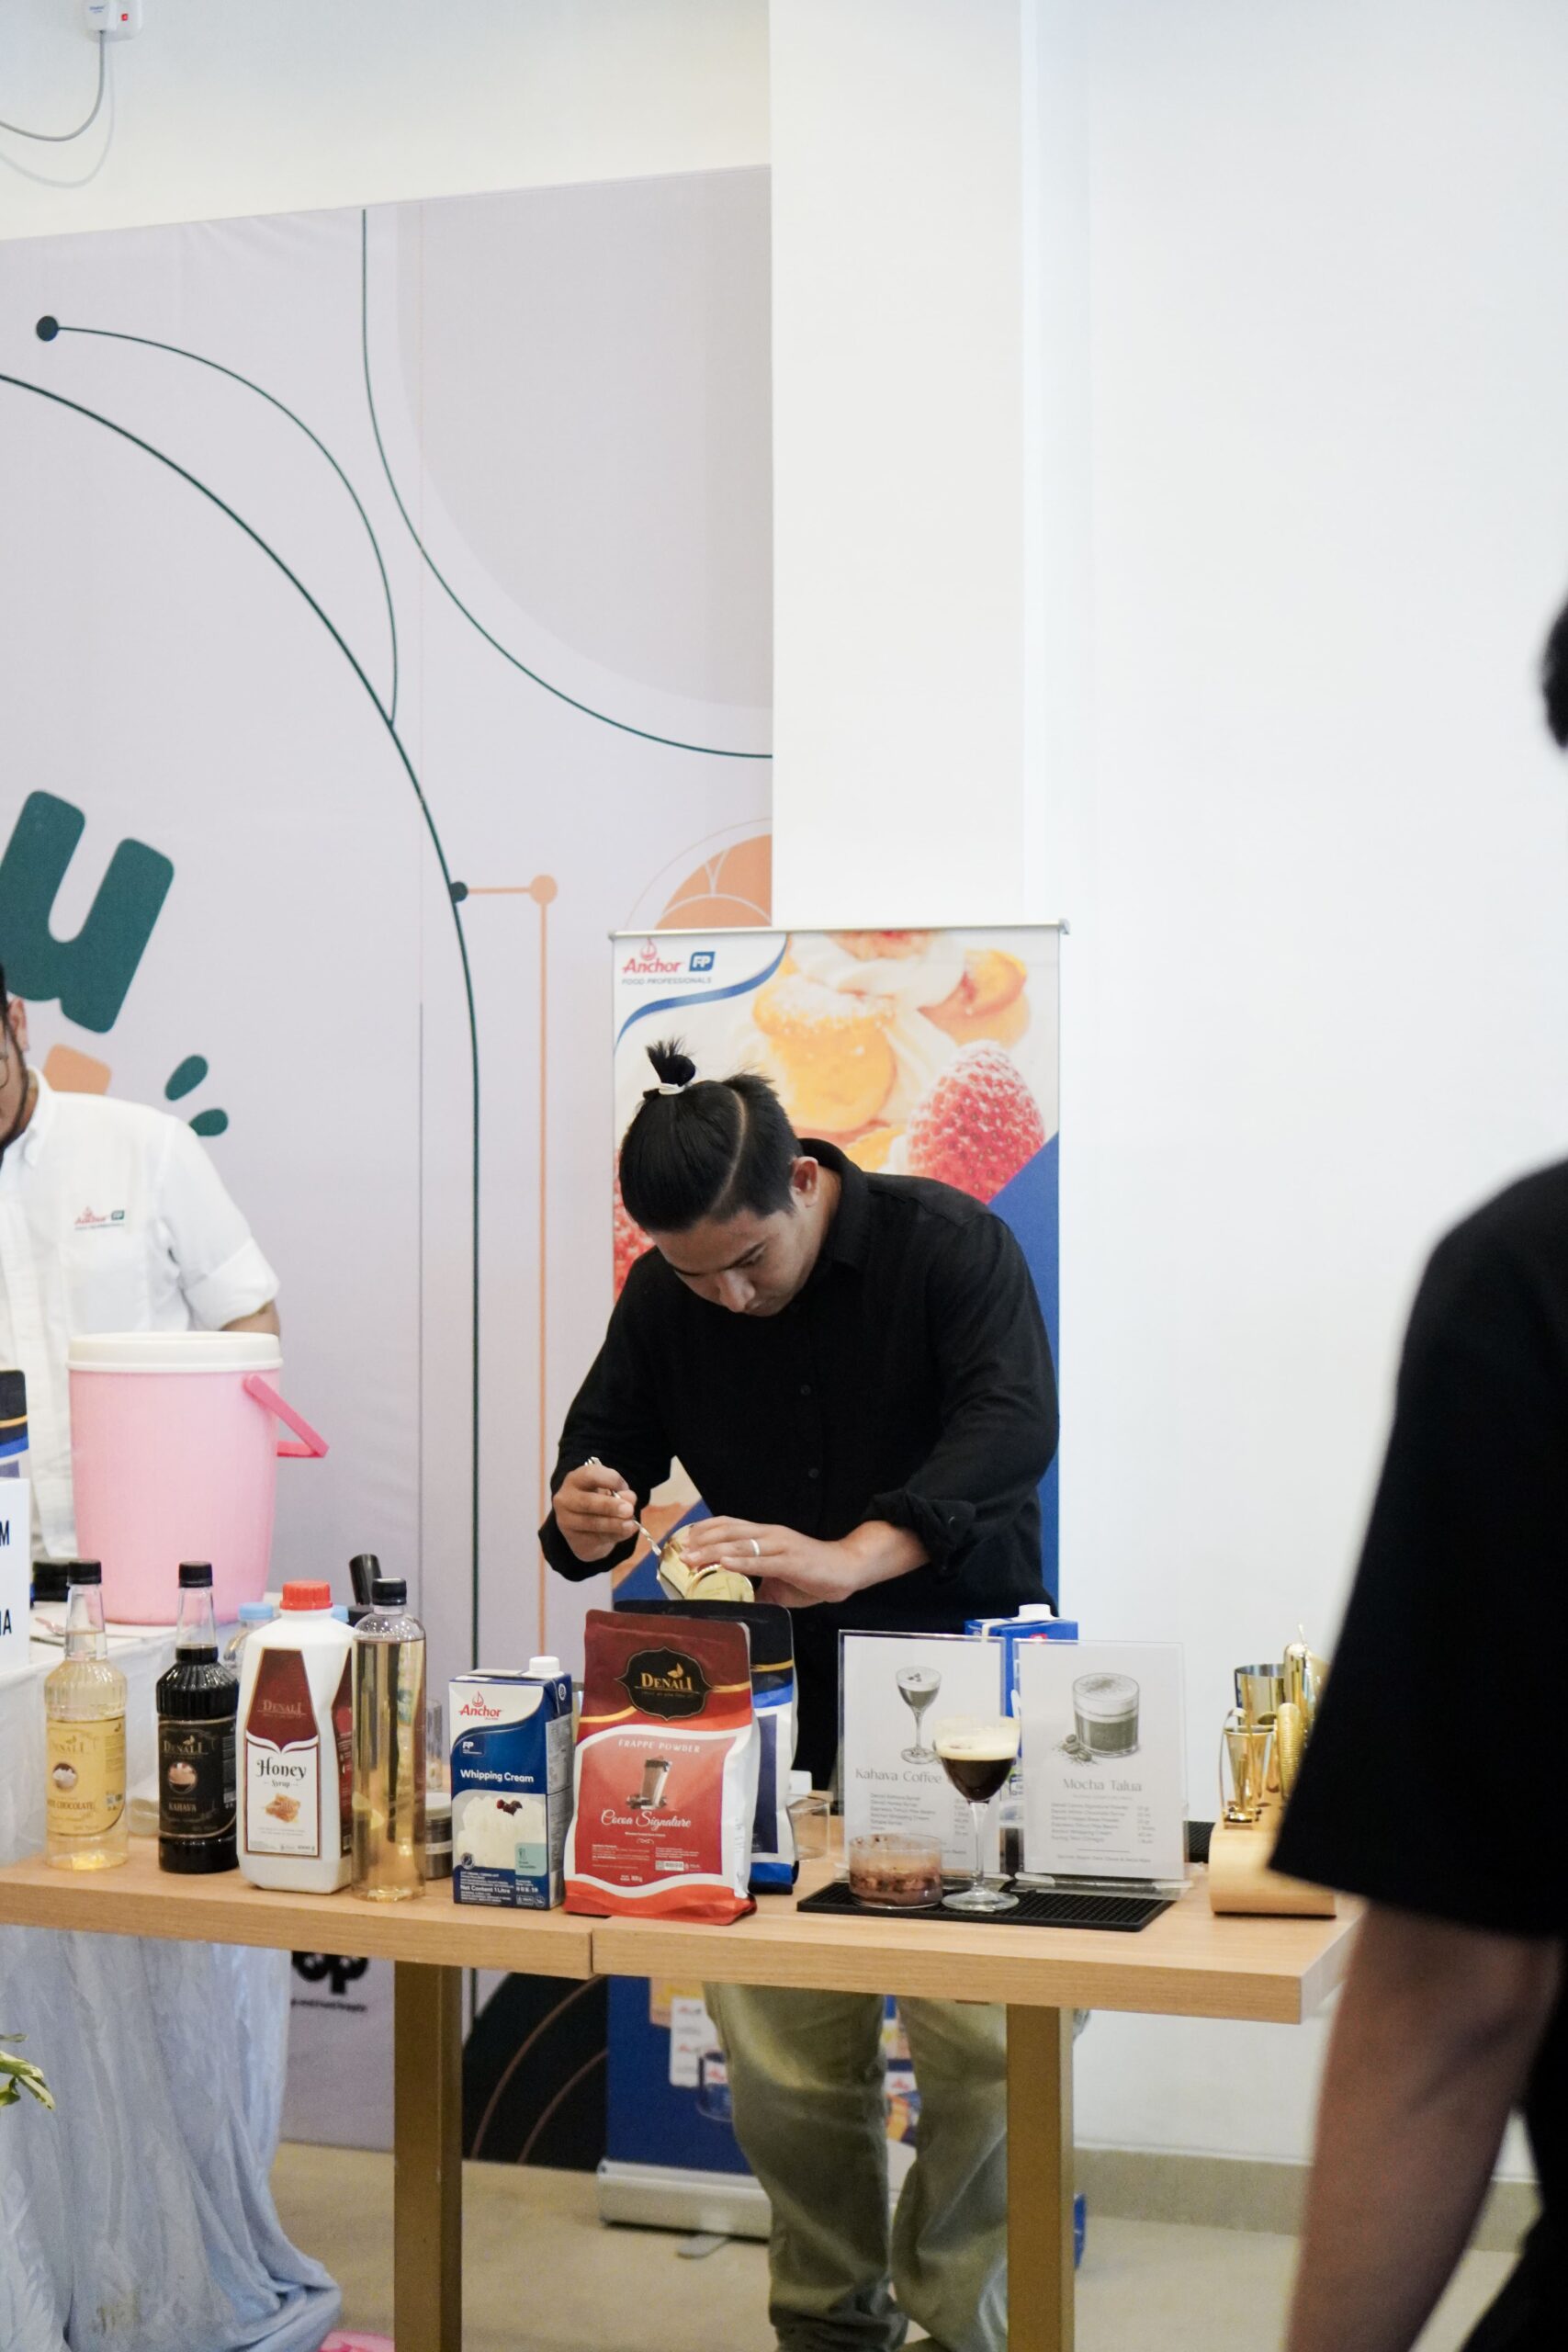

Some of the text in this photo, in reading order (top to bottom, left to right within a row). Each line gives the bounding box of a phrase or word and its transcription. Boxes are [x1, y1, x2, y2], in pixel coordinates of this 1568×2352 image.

[622, 957, 682, 973] Anchor
[647, 977, 712, 985] PROFESSIONALS
[0, 1609, 12, 1636] A
[640, 1673, 693, 1691] DENALI
[458, 1703, 502, 1718] Anchor
[462, 1741, 474, 1749] FP
[618, 1739, 701, 1753] FRAPPE POWDER
[255, 1756, 307, 1781] Honey
[459, 1769, 535, 1783] Whipping Cream
[855, 1769, 942, 1783] Kahava Coffee
[272, 1780, 290, 1789] Syrup
[1063, 1778, 1105, 1791] Mocha
[601, 1809, 692, 1831] Cocoa Signature
